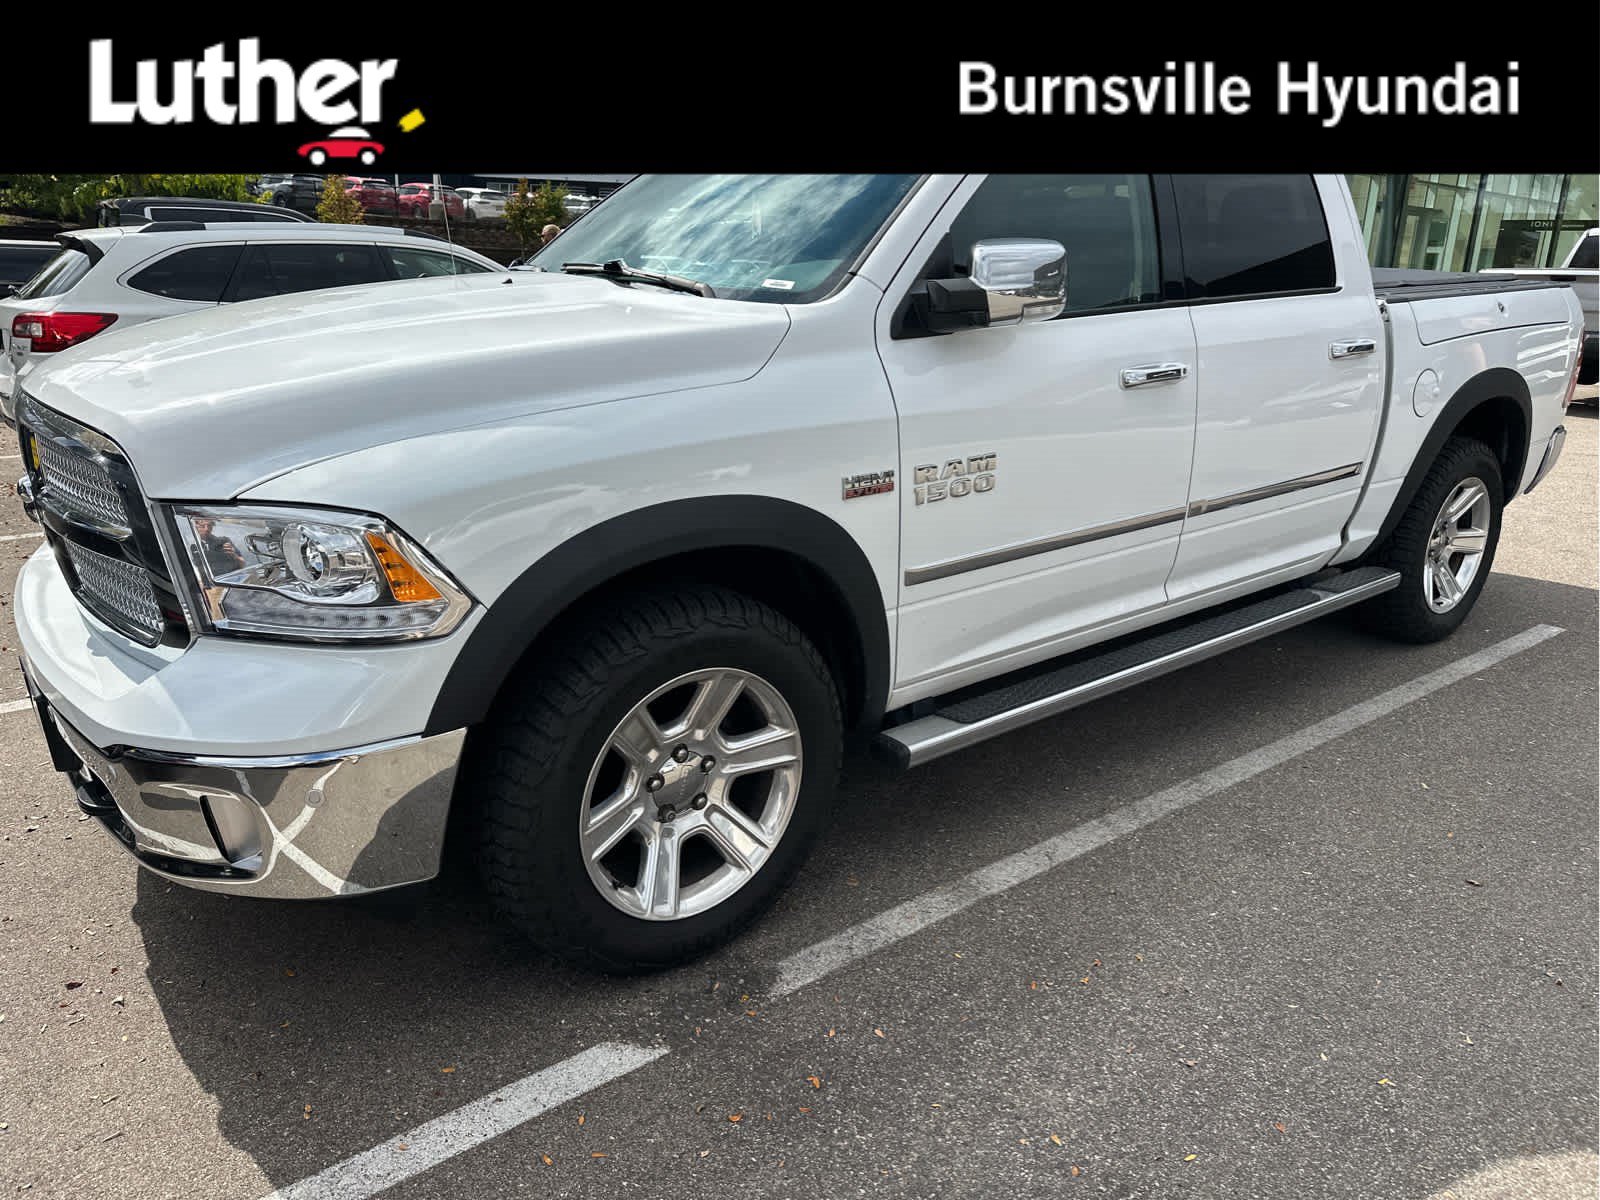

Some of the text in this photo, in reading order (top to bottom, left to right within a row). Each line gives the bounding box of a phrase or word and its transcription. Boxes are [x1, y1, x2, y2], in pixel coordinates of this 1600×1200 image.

[1530, 220, 1553, 228] IONI
[914, 453, 996, 485] RAM
[914, 473, 995, 506] 1500
